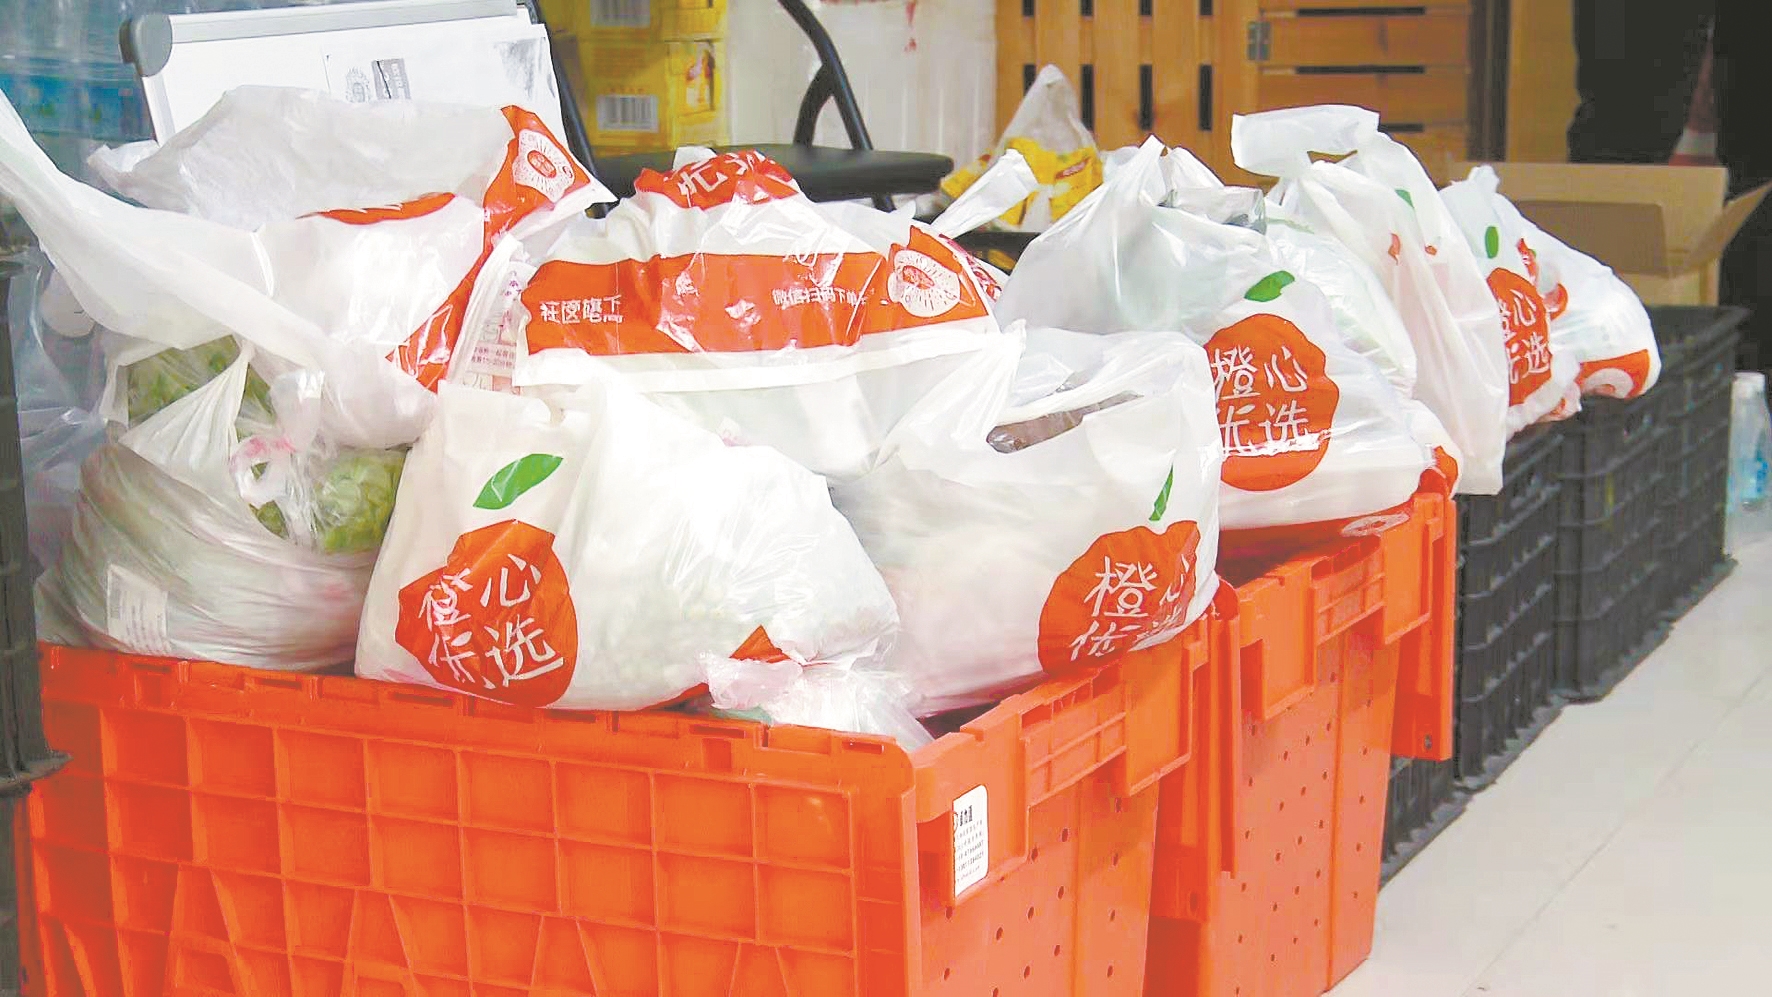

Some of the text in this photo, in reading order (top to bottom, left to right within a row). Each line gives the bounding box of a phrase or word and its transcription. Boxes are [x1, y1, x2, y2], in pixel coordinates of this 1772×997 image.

[1210, 345, 1308, 400] 橙心
[418, 554, 542, 630] 橙心
[428, 614, 564, 690] 优选
